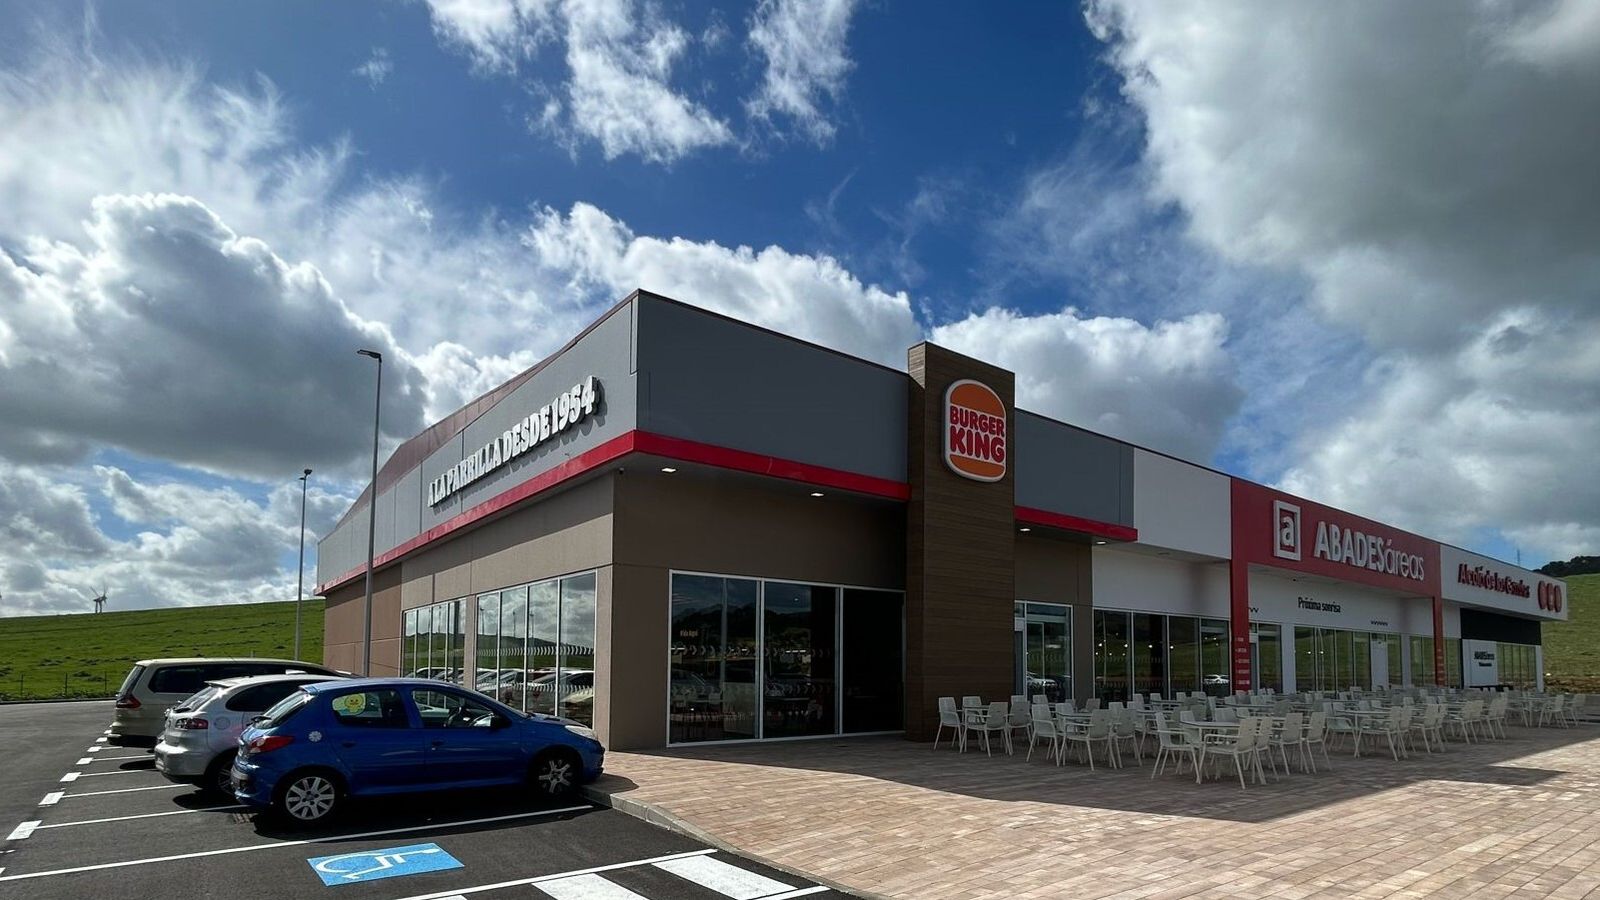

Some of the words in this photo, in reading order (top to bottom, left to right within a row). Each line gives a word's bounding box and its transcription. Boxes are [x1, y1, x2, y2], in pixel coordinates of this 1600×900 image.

[435, 473, 448, 504] LA
[447, 438, 503, 496] PARRILLA
[502, 403, 551, 462] DESDE
[551, 375, 596, 434] 1954
[950, 405, 1005, 437] BURGER
[950, 425, 1005, 463] KING
